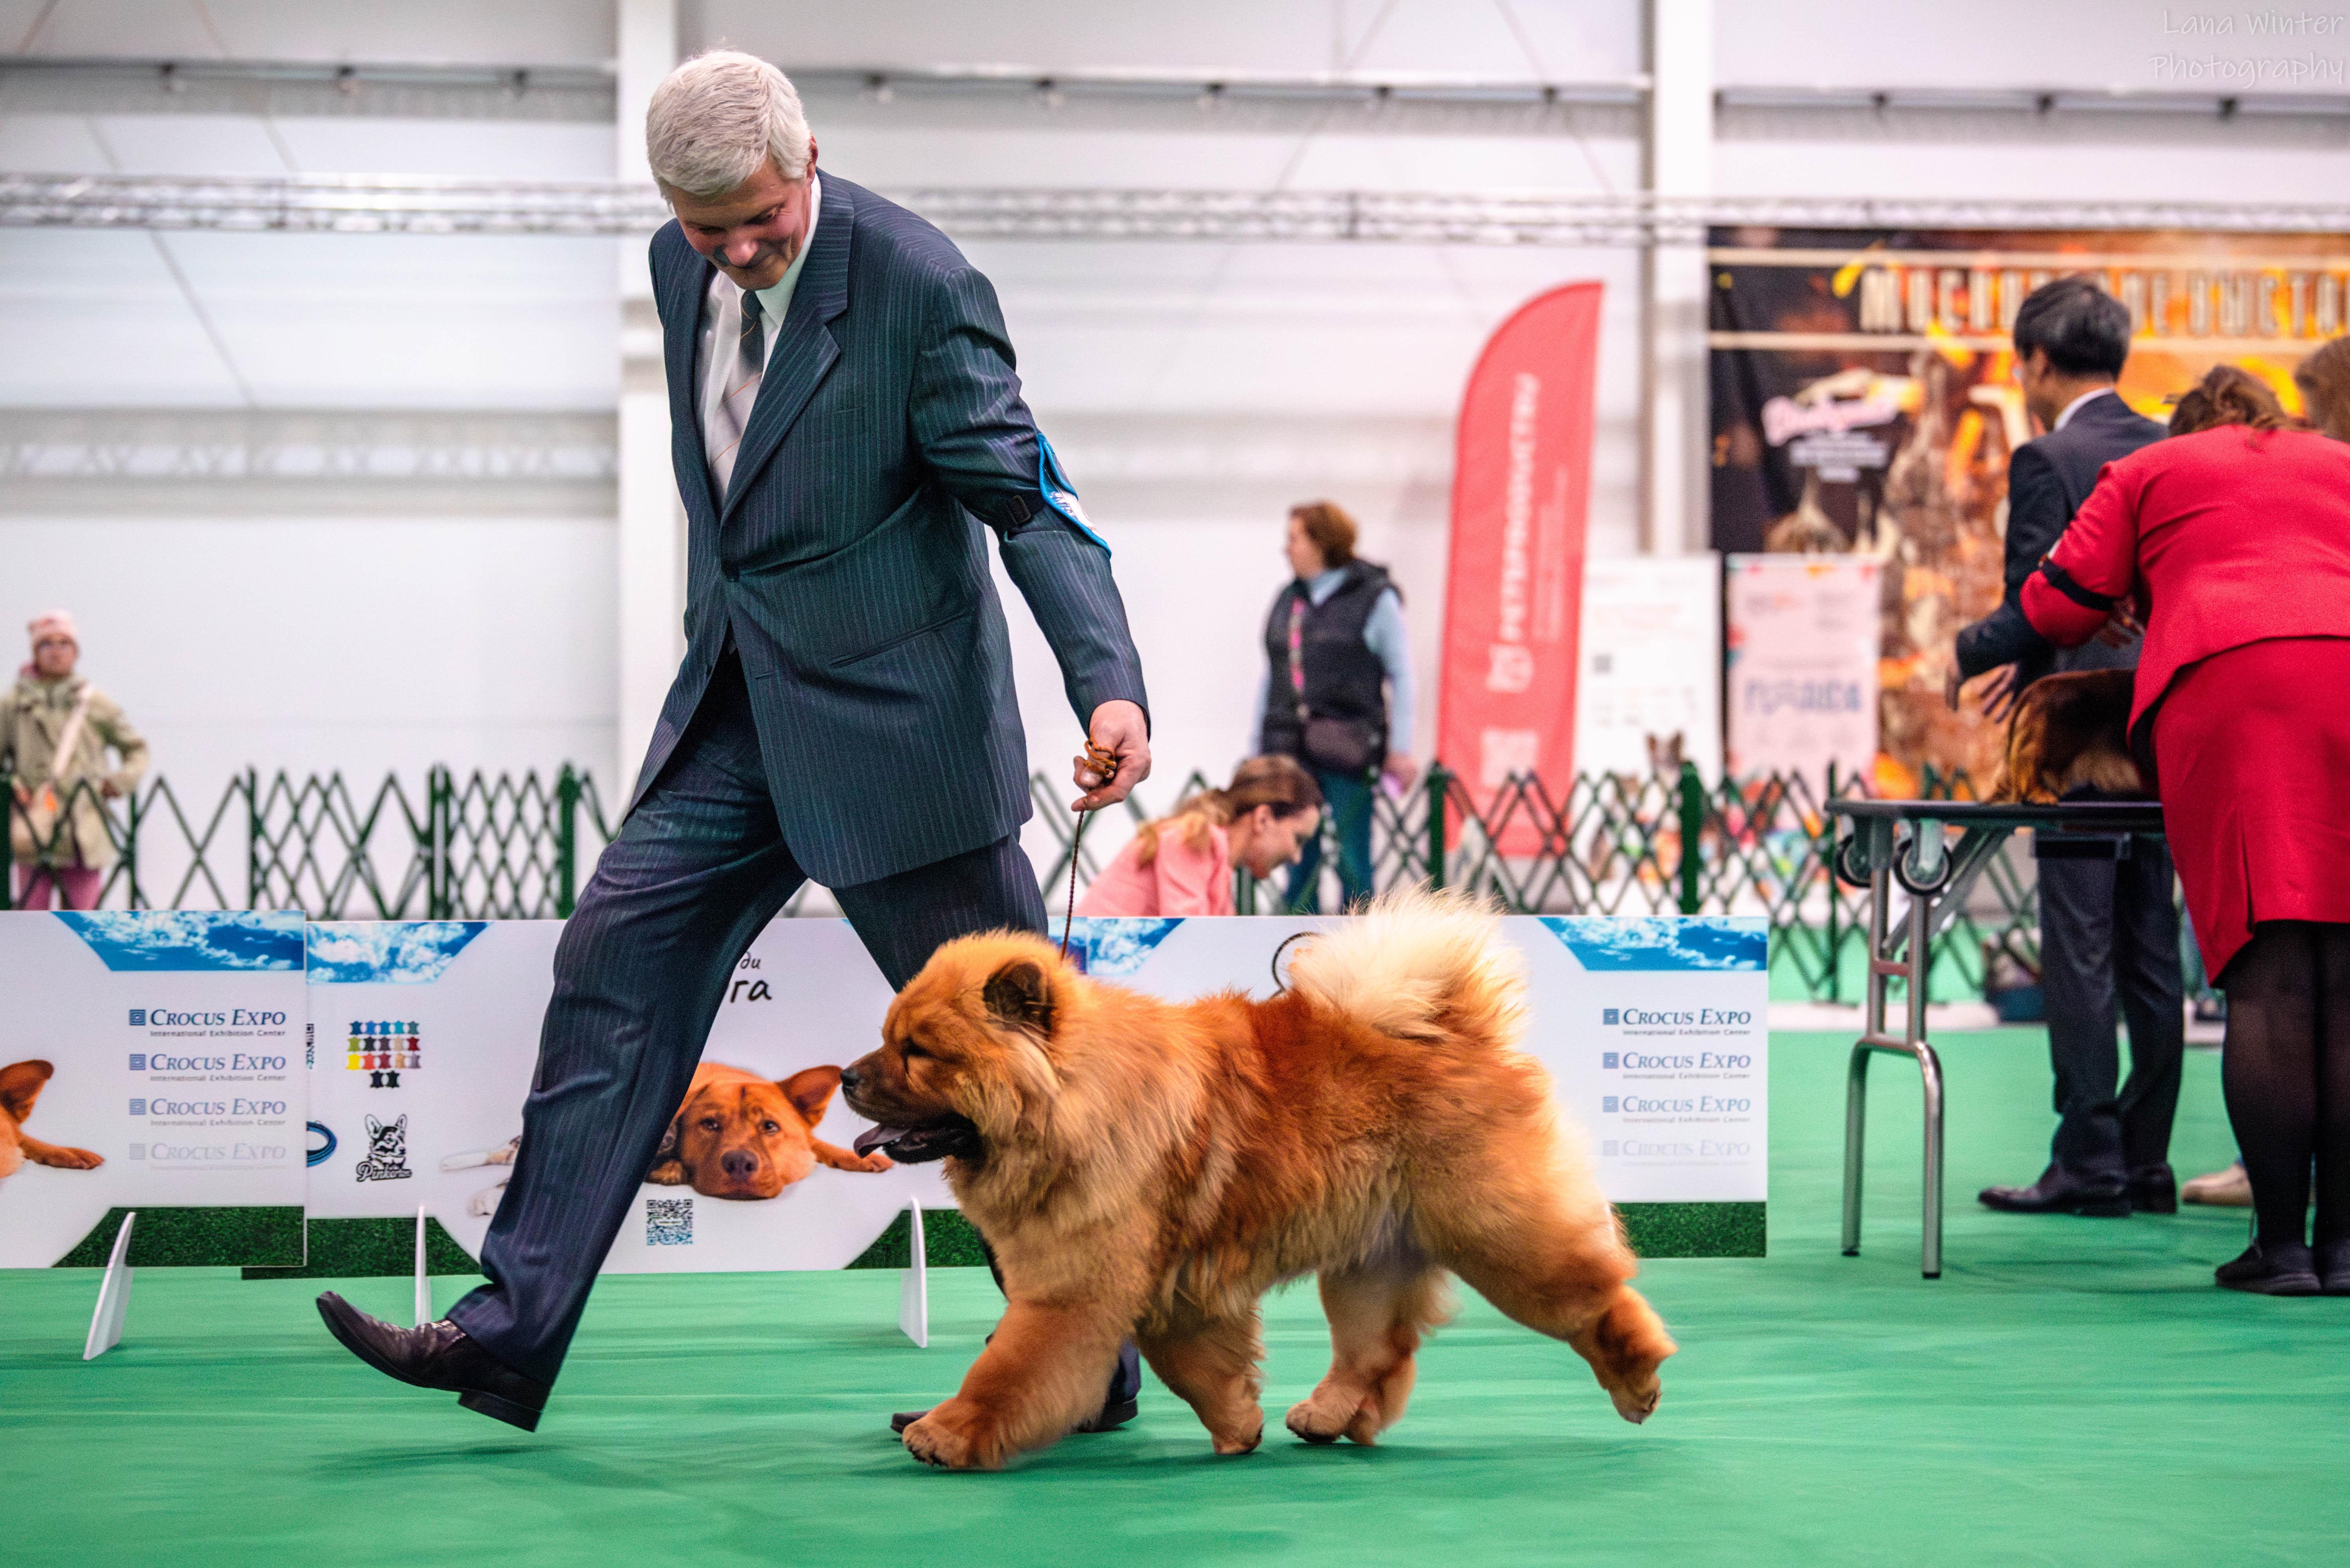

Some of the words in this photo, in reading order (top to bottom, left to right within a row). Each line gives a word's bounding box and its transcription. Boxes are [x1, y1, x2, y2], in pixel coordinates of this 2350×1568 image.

[151, 1009, 225, 1026] CROCUS
[231, 1009, 286, 1026] EXPO
[1623, 1008, 1694, 1025] CROCUS
[1700, 1008, 1751, 1025] EXPO
[151, 1054, 225, 1071] CROCUS
[231, 1054, 286, 1071] EXPO
[1623, 1052, 1694, 1069] CROCUS
[1700, 1052, 1751, 1069] EXPO
[151, 1098, 225, 1115] CROCUS
[231, 1098, 286, 1115] EXPO
[1623, 1096, 1694, 1112] CROCUS
[1700, 1096, 1751, 1112] EXPO
